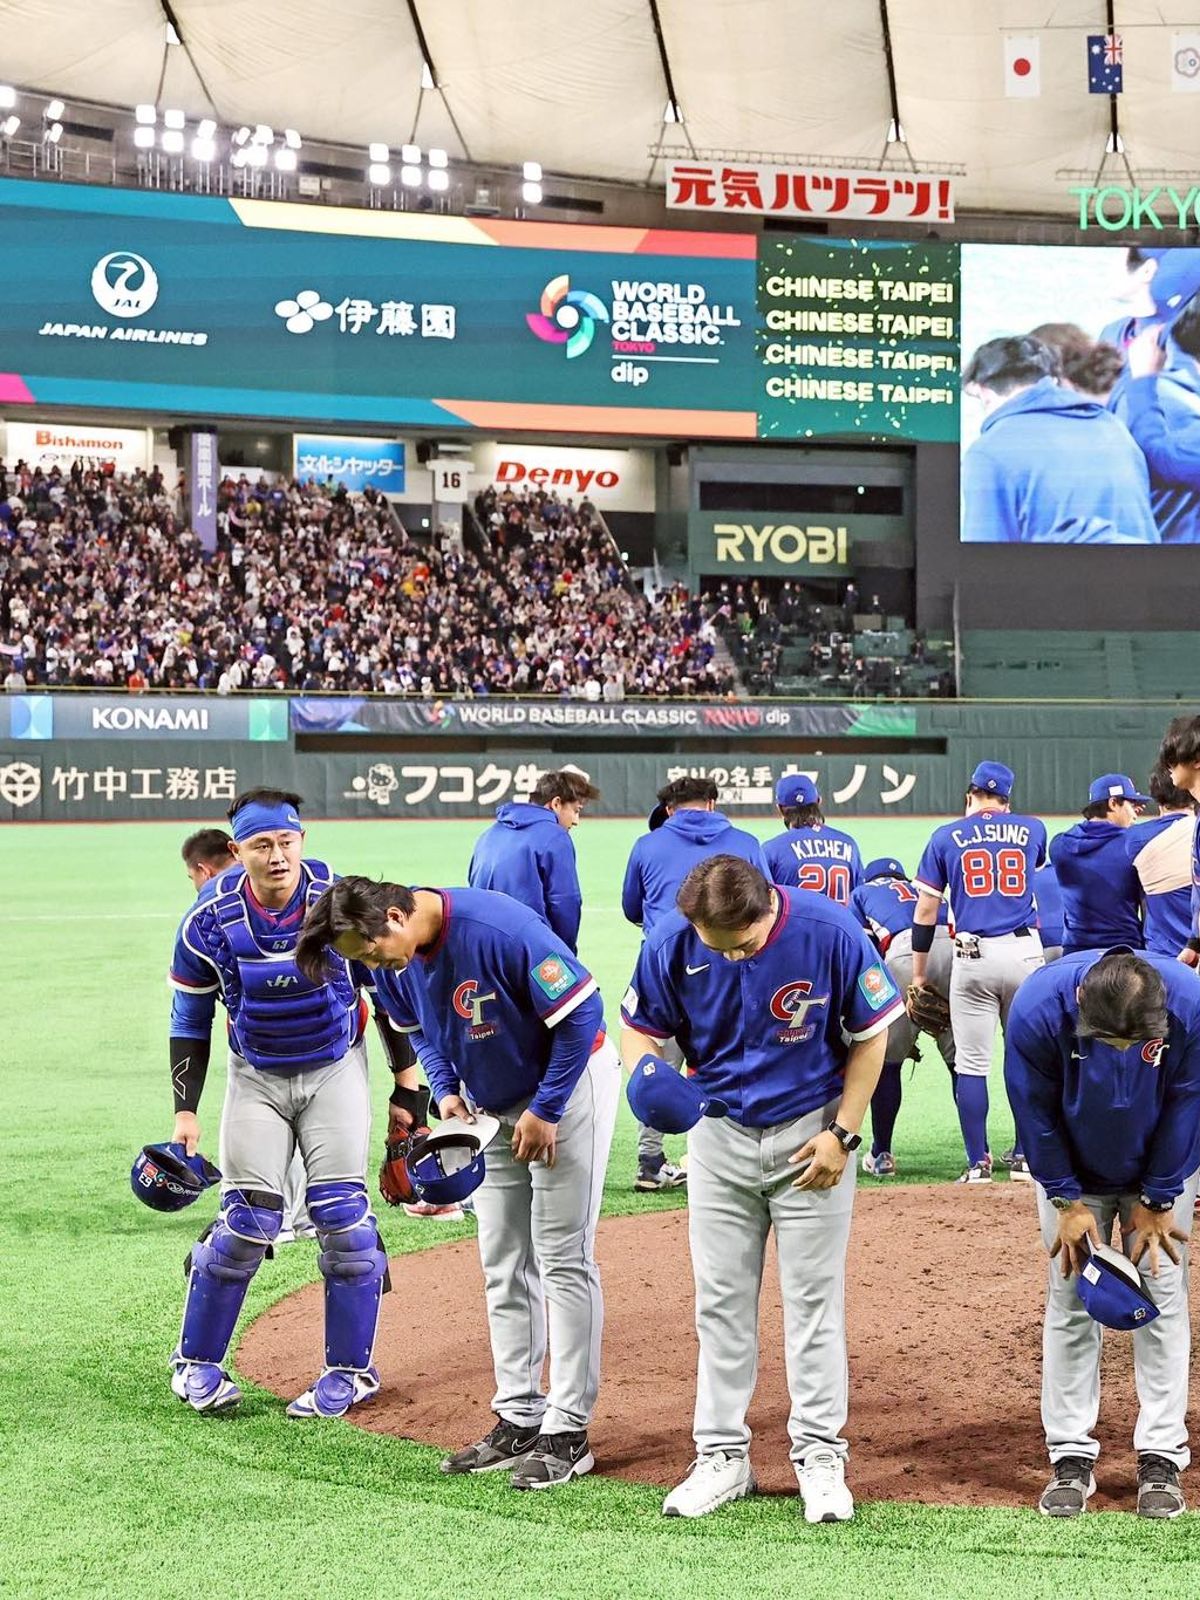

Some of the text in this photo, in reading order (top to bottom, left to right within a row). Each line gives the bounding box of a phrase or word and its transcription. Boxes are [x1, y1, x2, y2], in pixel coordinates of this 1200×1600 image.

[611, 280, 706, 305] WORLD
[766, 276, 953, 303] CHINESE TAIPEI
[335, 296, 456, 340] 伊藤園
[612, 300, 741, 327] BASEBALL
[766, 310, 953, 338] CHINESE TAIPEI
[38, 322, 208, 346] JAPAN AIRLINES
[612, 341, 656, 353] TOKYO
[765, 343, 874, 369] CHINESE
[611, 361, 649, 386] dip
[766, 377, 874, 402] CHINESE
[35, 429, 123, 450] Bishamon
[443, 472, 461, 489] 16
[496, 460, 620, 492] Denyo
[714, 524, 847, 564] RYOBI
[92, 707, 208, 730] KONAMI
[459, 707, 791, 726] WORLD BASEBALL CLASSIC TOKYO dip
[51, 766, 237, 801] 竹中工務店
[401, 763, 590, 805] フコク生
[952, 823, 1030, 848] C.J.SUNG
[798, 863, 851, 907] 20
[961, 848, 1026, 898] 88
